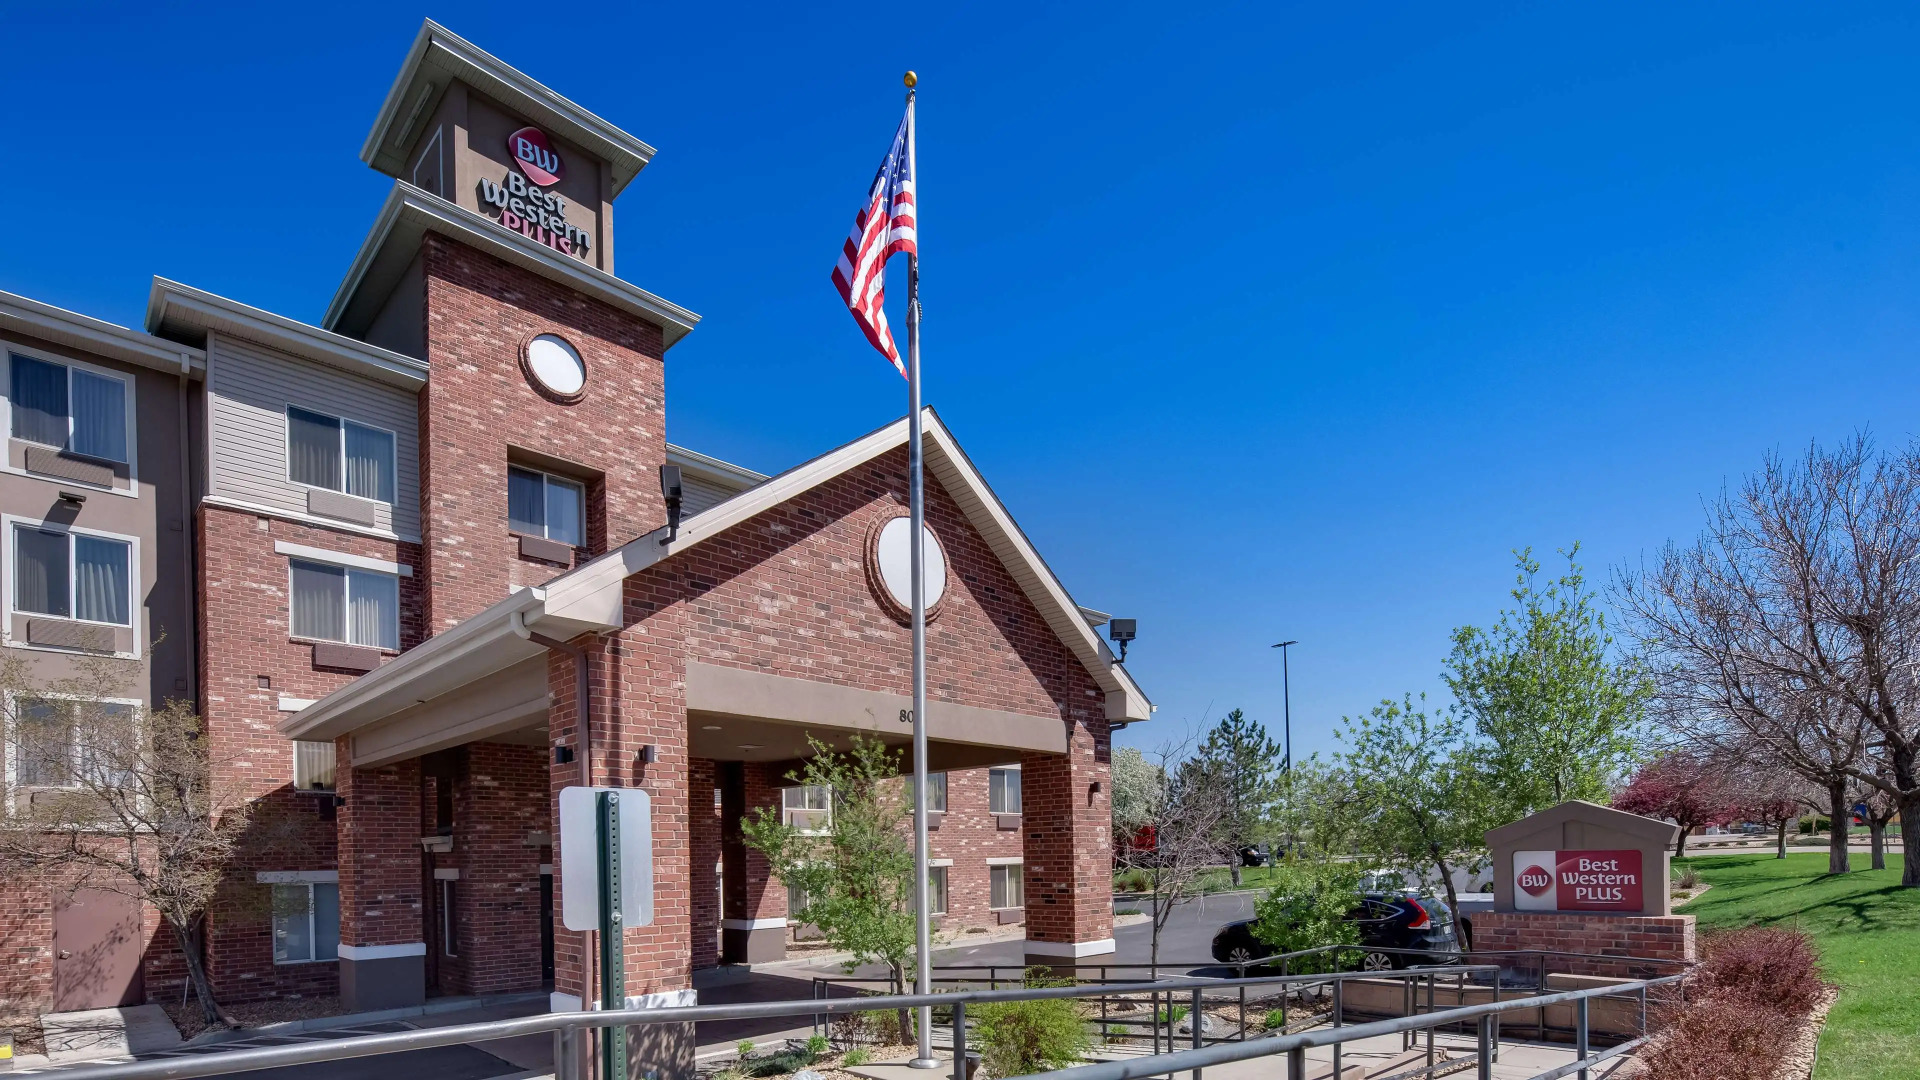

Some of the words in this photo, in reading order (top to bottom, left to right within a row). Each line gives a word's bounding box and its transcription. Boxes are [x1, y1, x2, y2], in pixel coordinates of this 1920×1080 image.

[517, 137, 558, 173] BW
[508, 171, 566, 217] Best
[481, 177, 590, 248] Western
[1579, 858, 1618, 872] Best
[1522, 875, 1548, 887] BW
[1562, 872, 1636, 885] Western
